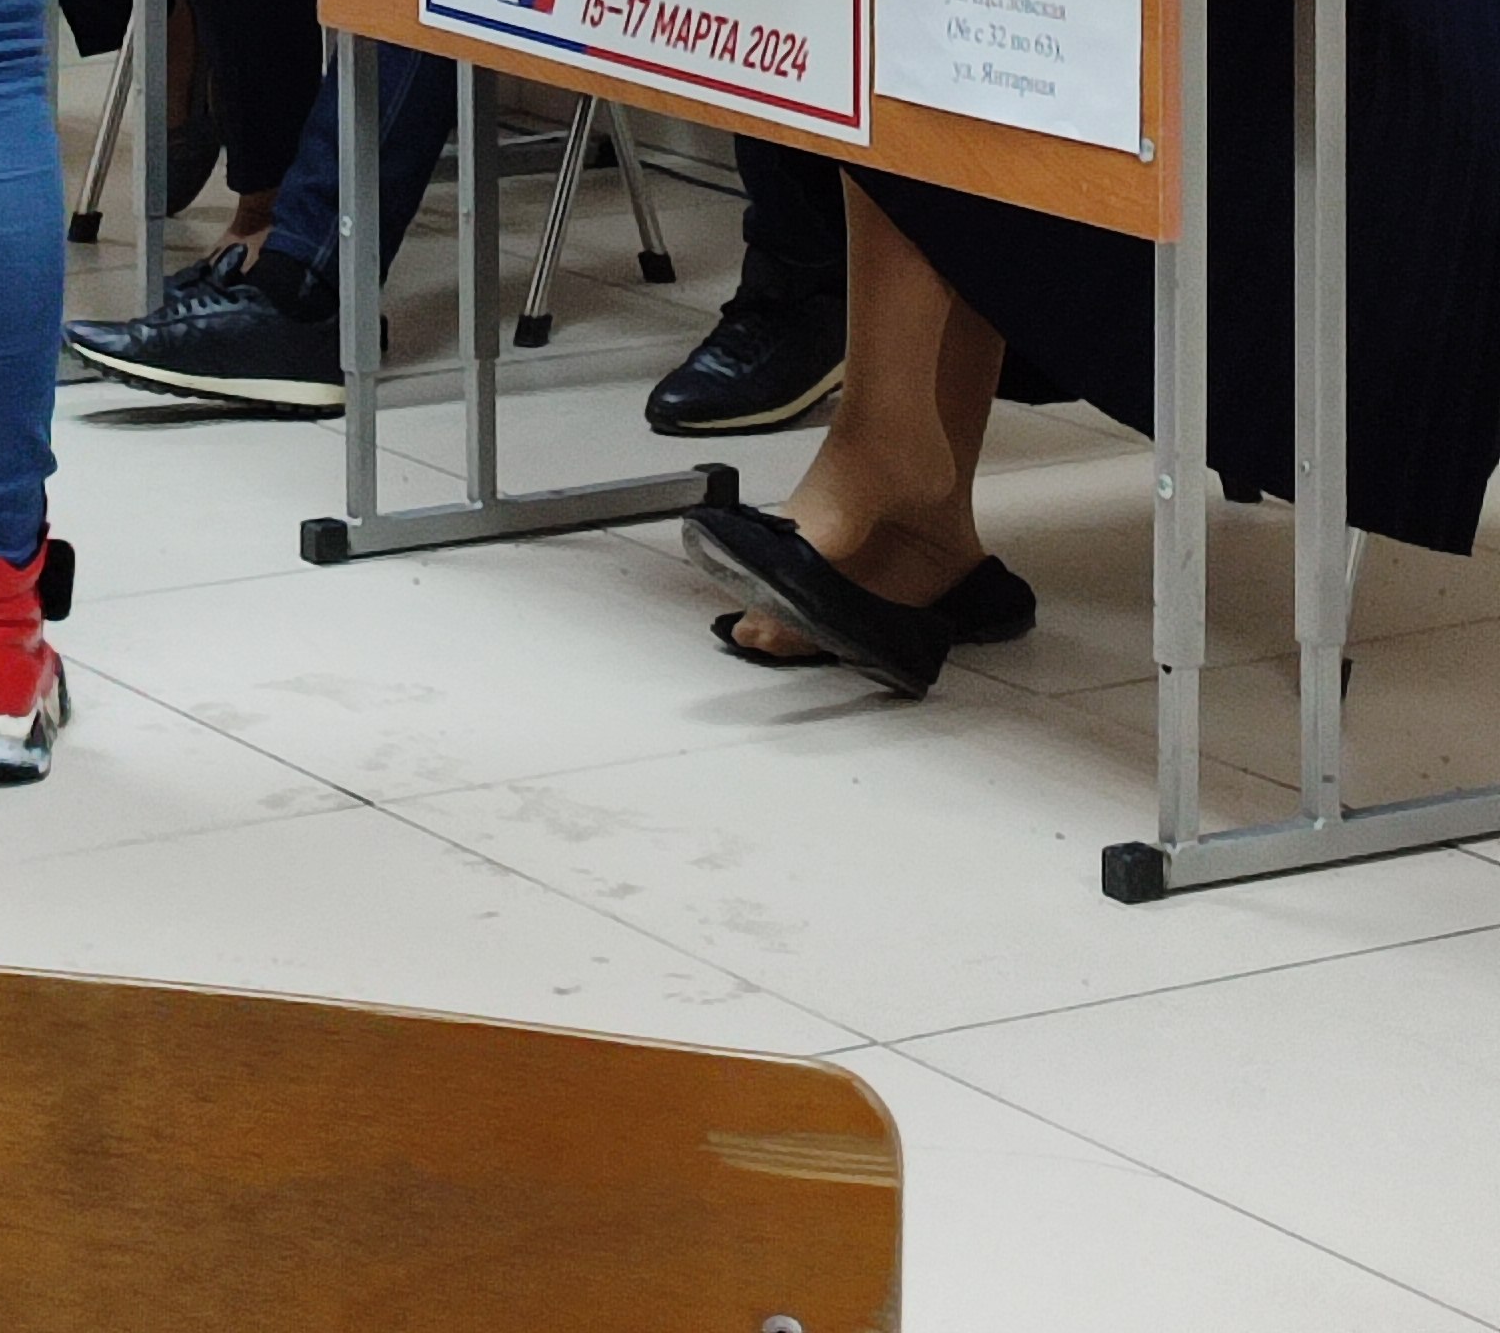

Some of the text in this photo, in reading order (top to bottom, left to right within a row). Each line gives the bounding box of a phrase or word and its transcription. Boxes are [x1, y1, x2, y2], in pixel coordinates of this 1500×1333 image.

[651, 0, 740, 64] МАРТА
[742, 24, 810, 82] 2024
[974, 27, 984, 45] с
[987, 22, 1007, 49] 32
[1010, 35, 1031, 53] по
[952, 60, 1057, 99] ул. Янтарная
